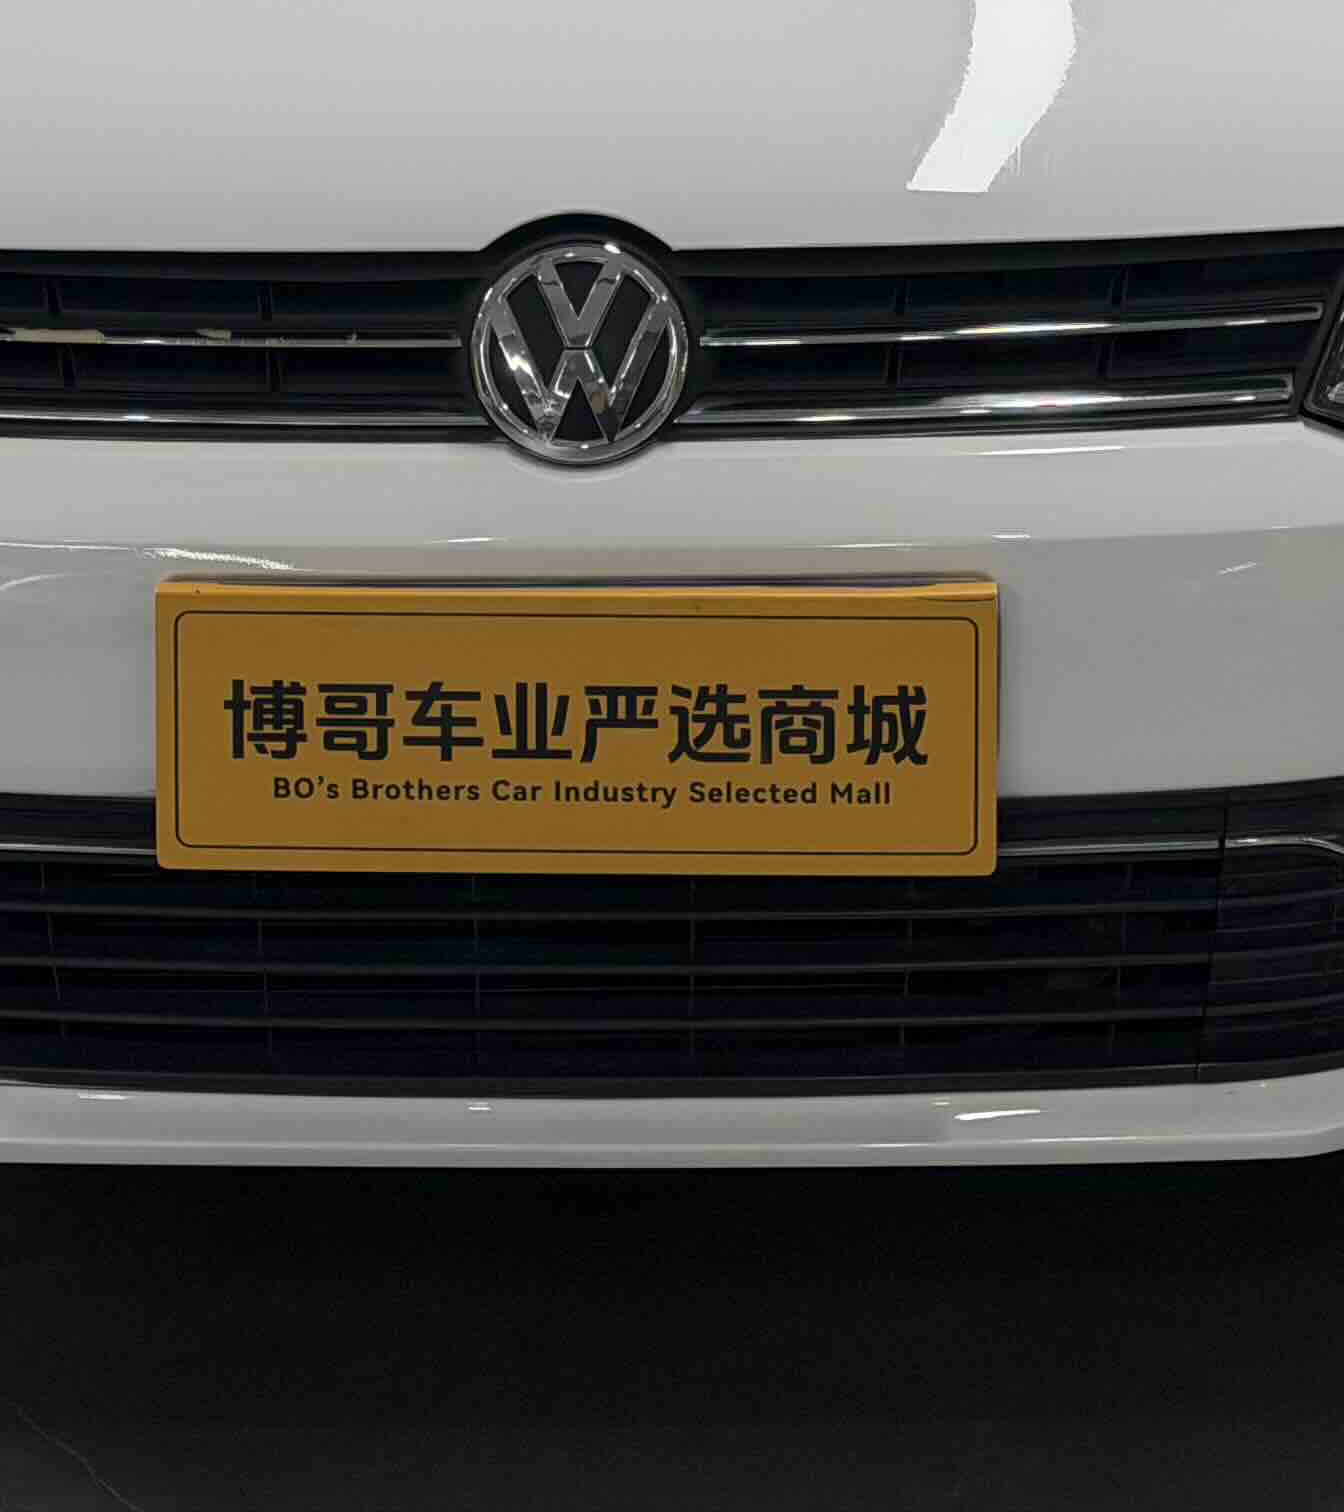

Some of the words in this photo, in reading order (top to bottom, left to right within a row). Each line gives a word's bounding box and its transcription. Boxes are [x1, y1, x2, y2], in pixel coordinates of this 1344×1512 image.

[224, 679, 929, 767] 博哥车业严选商城
[273, 776, 340, 800] BO's
[351, 776, 481, 802] Brothers
[491, 778, 542, 803] Car
[554, 778, 677, 810] Industry
[689, 780, 818, 805] Selected
[831, 780, 892, 806] Mall
